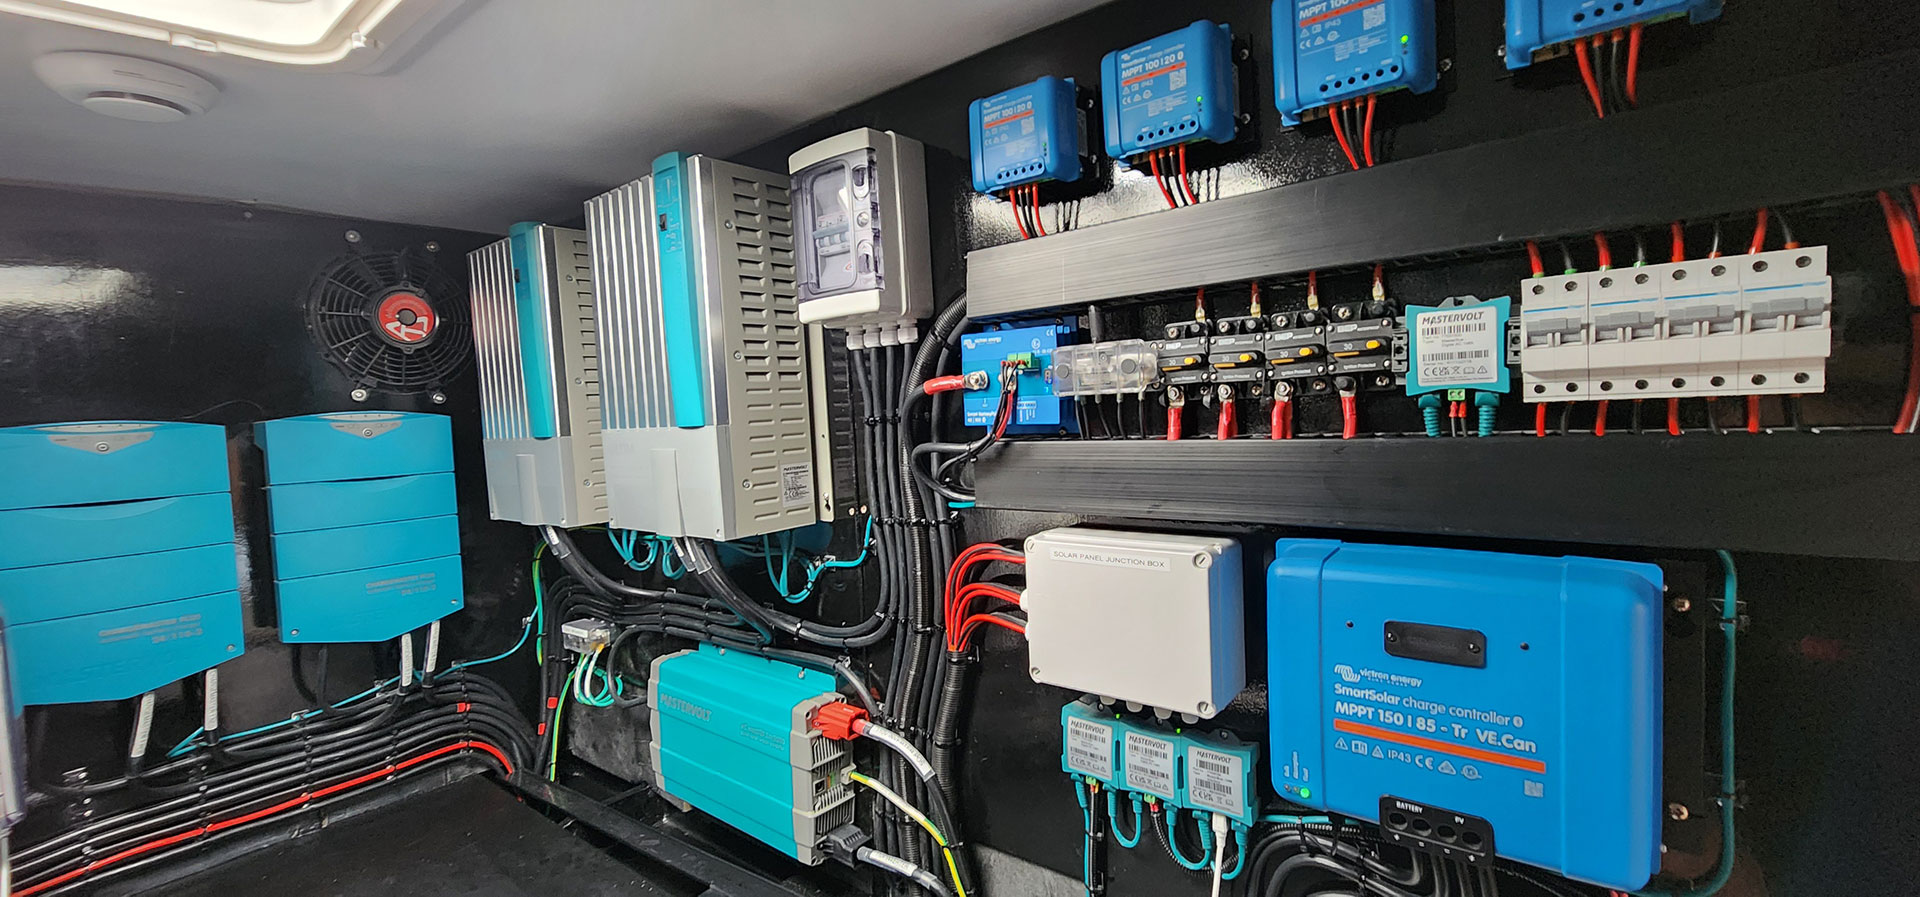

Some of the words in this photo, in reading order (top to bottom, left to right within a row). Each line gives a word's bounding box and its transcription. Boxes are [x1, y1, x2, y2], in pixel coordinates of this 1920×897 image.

[1299, 2, 1327, 20] MPPT
[1122, 64, 1143, 78] MPPT
[1422, 311, 1484, 326] MASTERVOLT
[1053, 550, 1078, 559] SOLAR
[1080, 553, 1104, 562] PANEL
[1106, 556, 1145, 566] JUNCTION
[1147, 560, 1165, 568] BOX
[1360, 668, 1389, 681] victron
[1390, 674, 1422, 688] energy
[660, 693, 712, 722] MASTERVOLT
[1334, 683, 1401, 707] SmartSolar
[1402, 696, 1446, 715] charge
[1448, 704, 1511, 727] controller
[1070, 720, 1105, 735] MASTERVOLT
[1334, 701, 1376, 720] MPPT
[1376, 708, 1404, 726] 150
[1416, 716, 1436, 734] 85
[1450, 722, 1468, 740] Tr
[1475, 728, 1537, 754] VE.Can
[1128, 735, 1167, 750] MASTERVOLT
[1196, 750, 1232, 764] MASTERVOLT
[1388, 749, 1412, 764] IP43
[1396, 800, 1424, 814] BATTERY
[1454, 816, 1465, 825] PV
